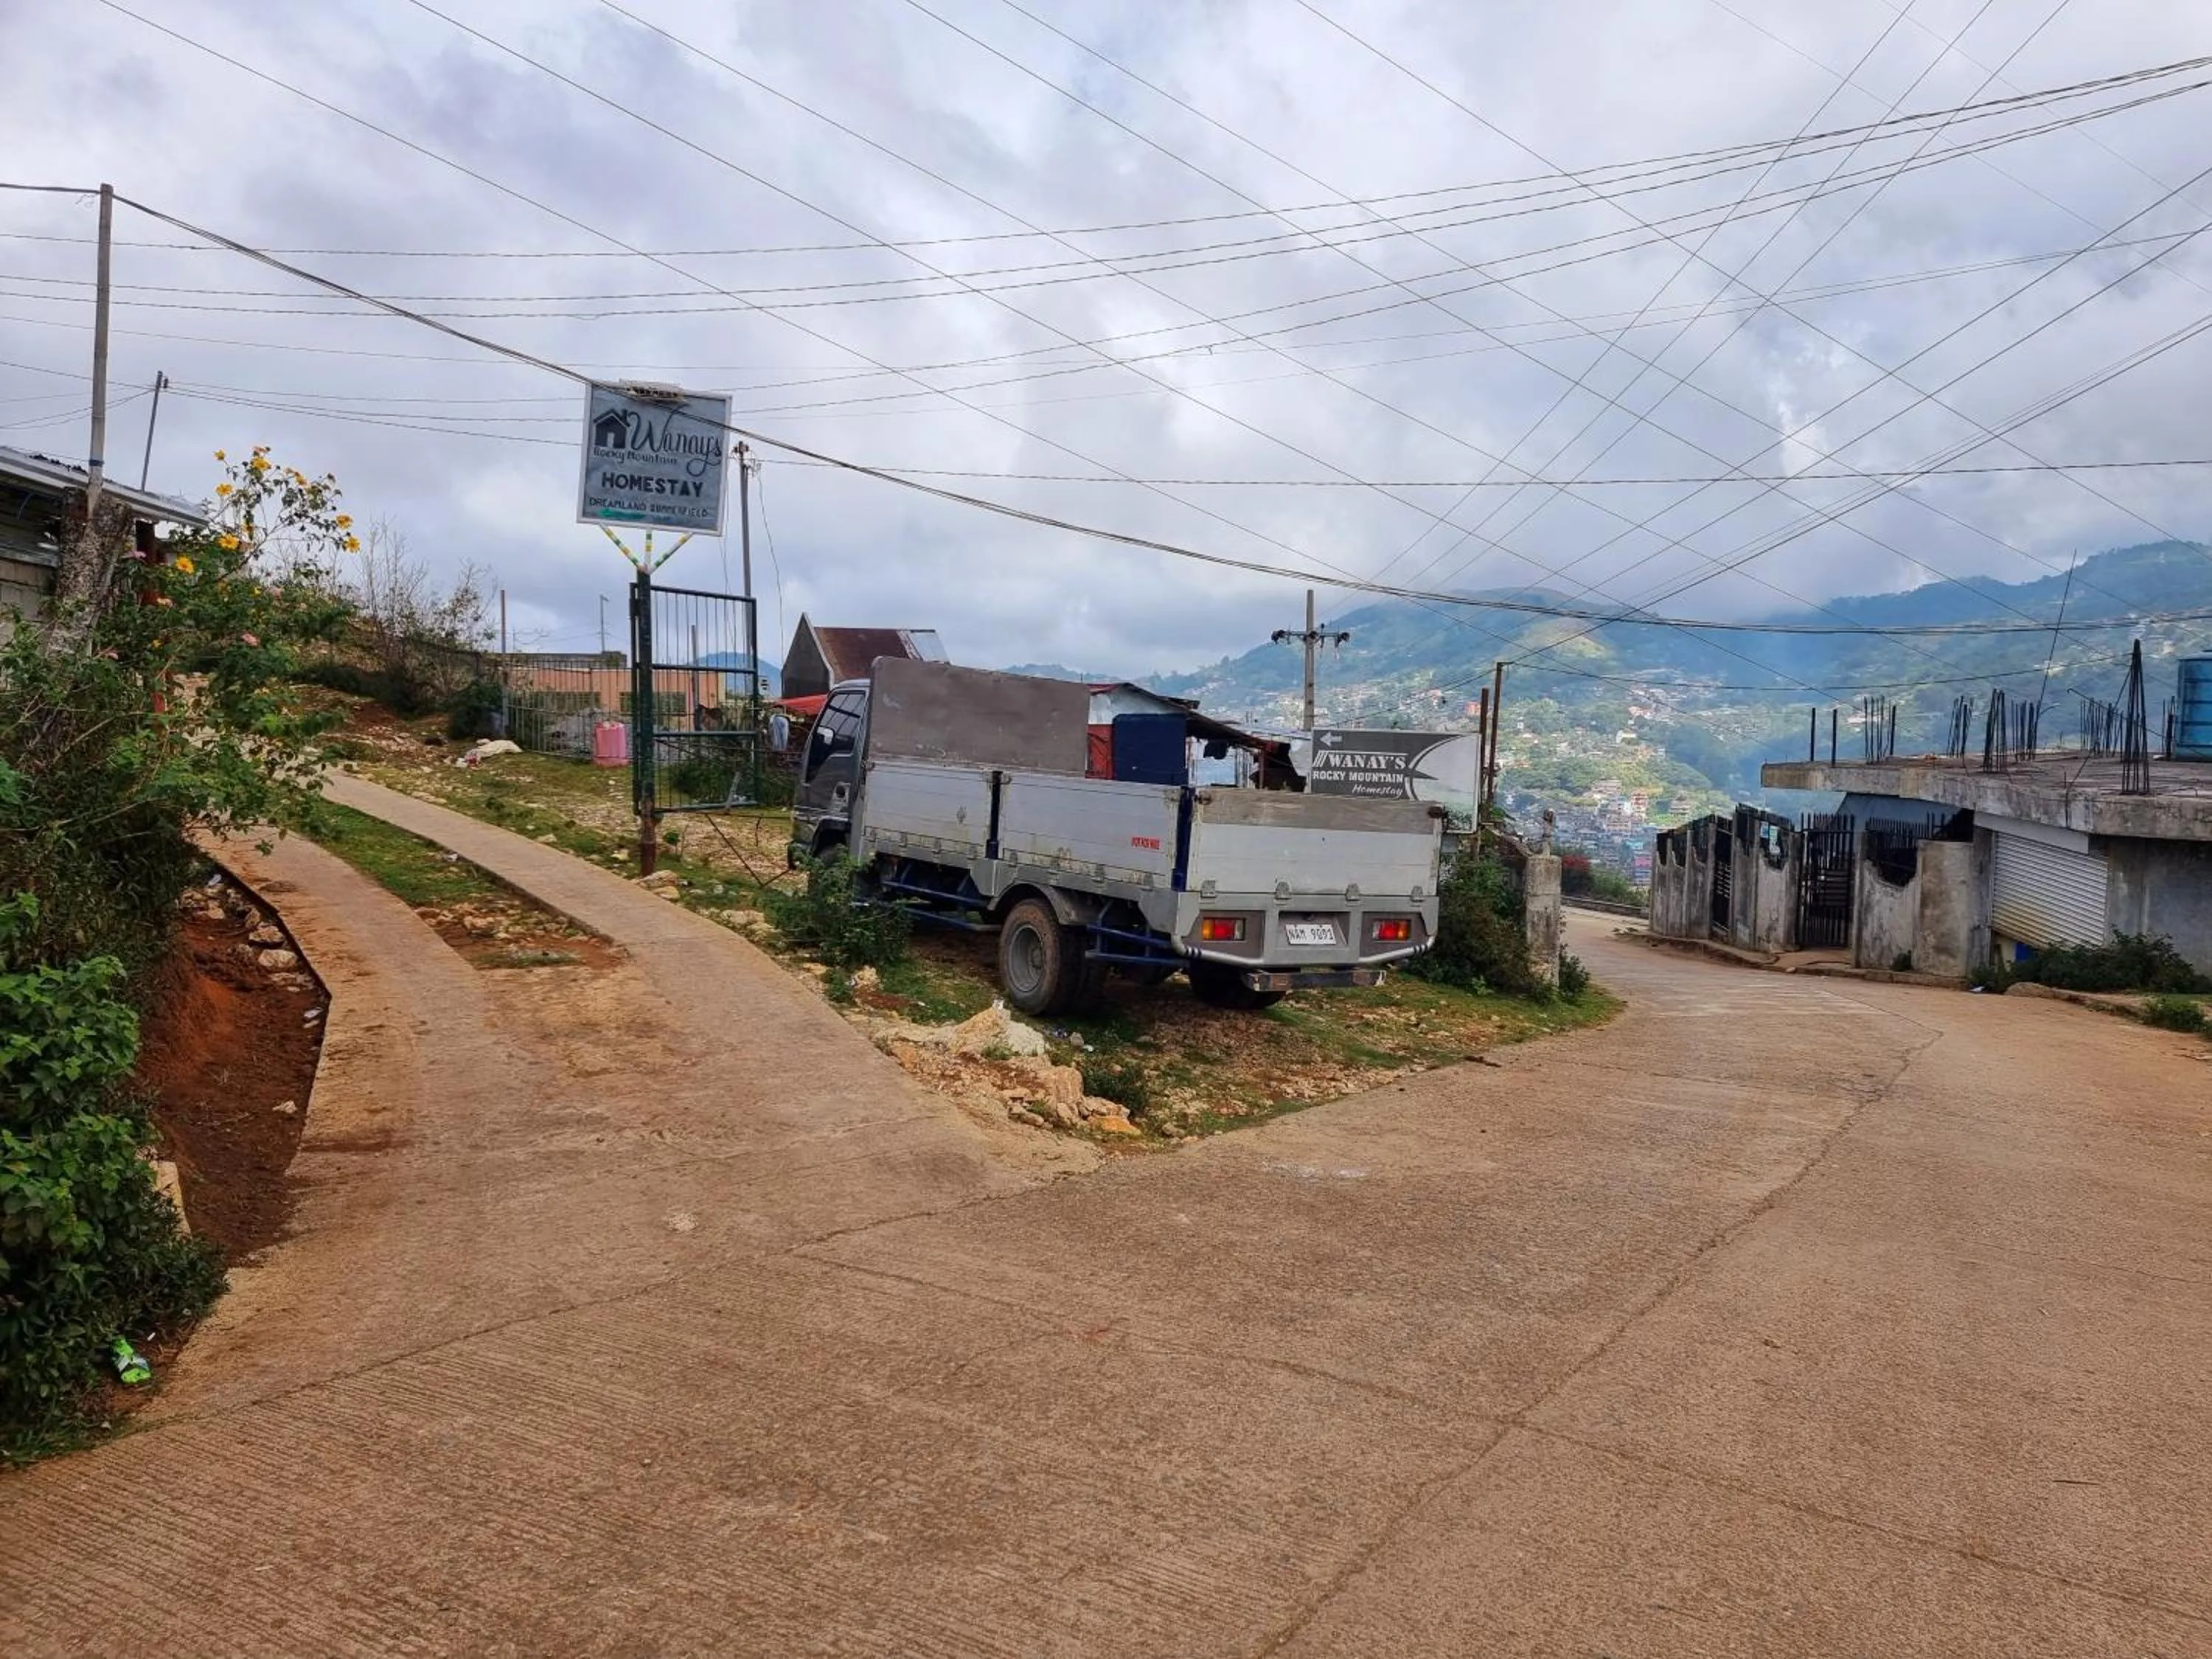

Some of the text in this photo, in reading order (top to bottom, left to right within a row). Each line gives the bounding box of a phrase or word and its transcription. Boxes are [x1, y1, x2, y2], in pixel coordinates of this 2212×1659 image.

[601, 471, 703, 498] HOMESTAY
[589, 496, 647, 512] DREAMLAND
[1328, 754, 1406, 770] WANAY'S
[1312, 771, 1404, 783] ROCKY MOUNTAIN
[1352, 784, 1403, 796] Homestay
